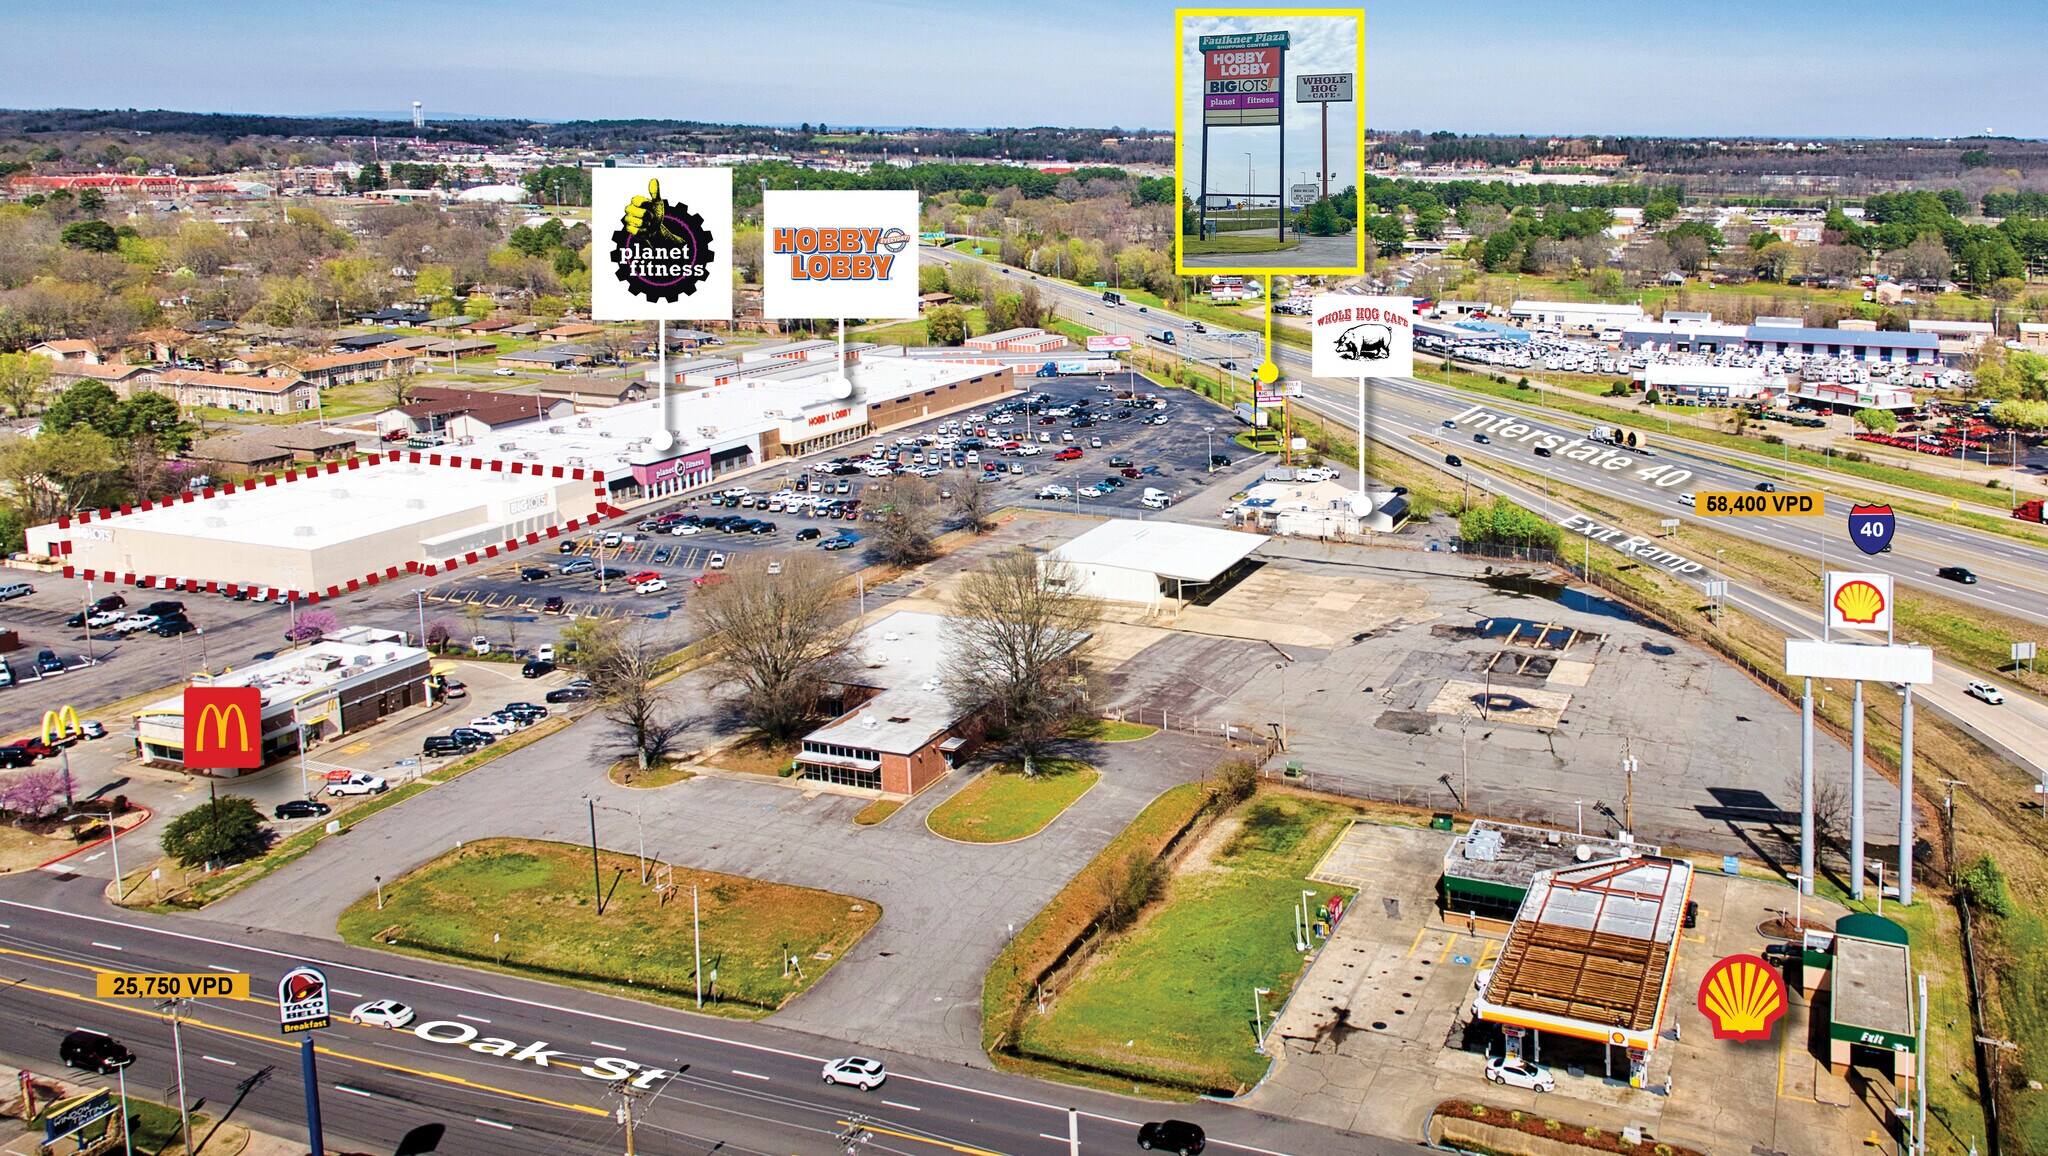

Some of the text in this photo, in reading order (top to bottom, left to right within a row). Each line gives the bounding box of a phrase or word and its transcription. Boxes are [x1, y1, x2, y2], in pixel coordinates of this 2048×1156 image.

[1202, 33, 1285, 46] Faulkner Plaza
[1213, 51, 1266, 65] HOBBY
[1221, 63, 1270, 76] LOBBY
[1302, 76, 1347, 85] WHOLE
[1311, 85, 1338, 93] HOG
[1210, 96, 1275, 107] planet fitness
[831, 407, 852, 421] LOBBY
[283, 1001, 324, 1012] TACO
[286, 1008, 325, 1020] BELL
[283, 1019, 328, 1033] Breakfast
[1860, 1031, 1885, 1045] Exit
[53, 1102, 92, 1127] WINDOW
[71, 1100, 110, 1124] TINTING
